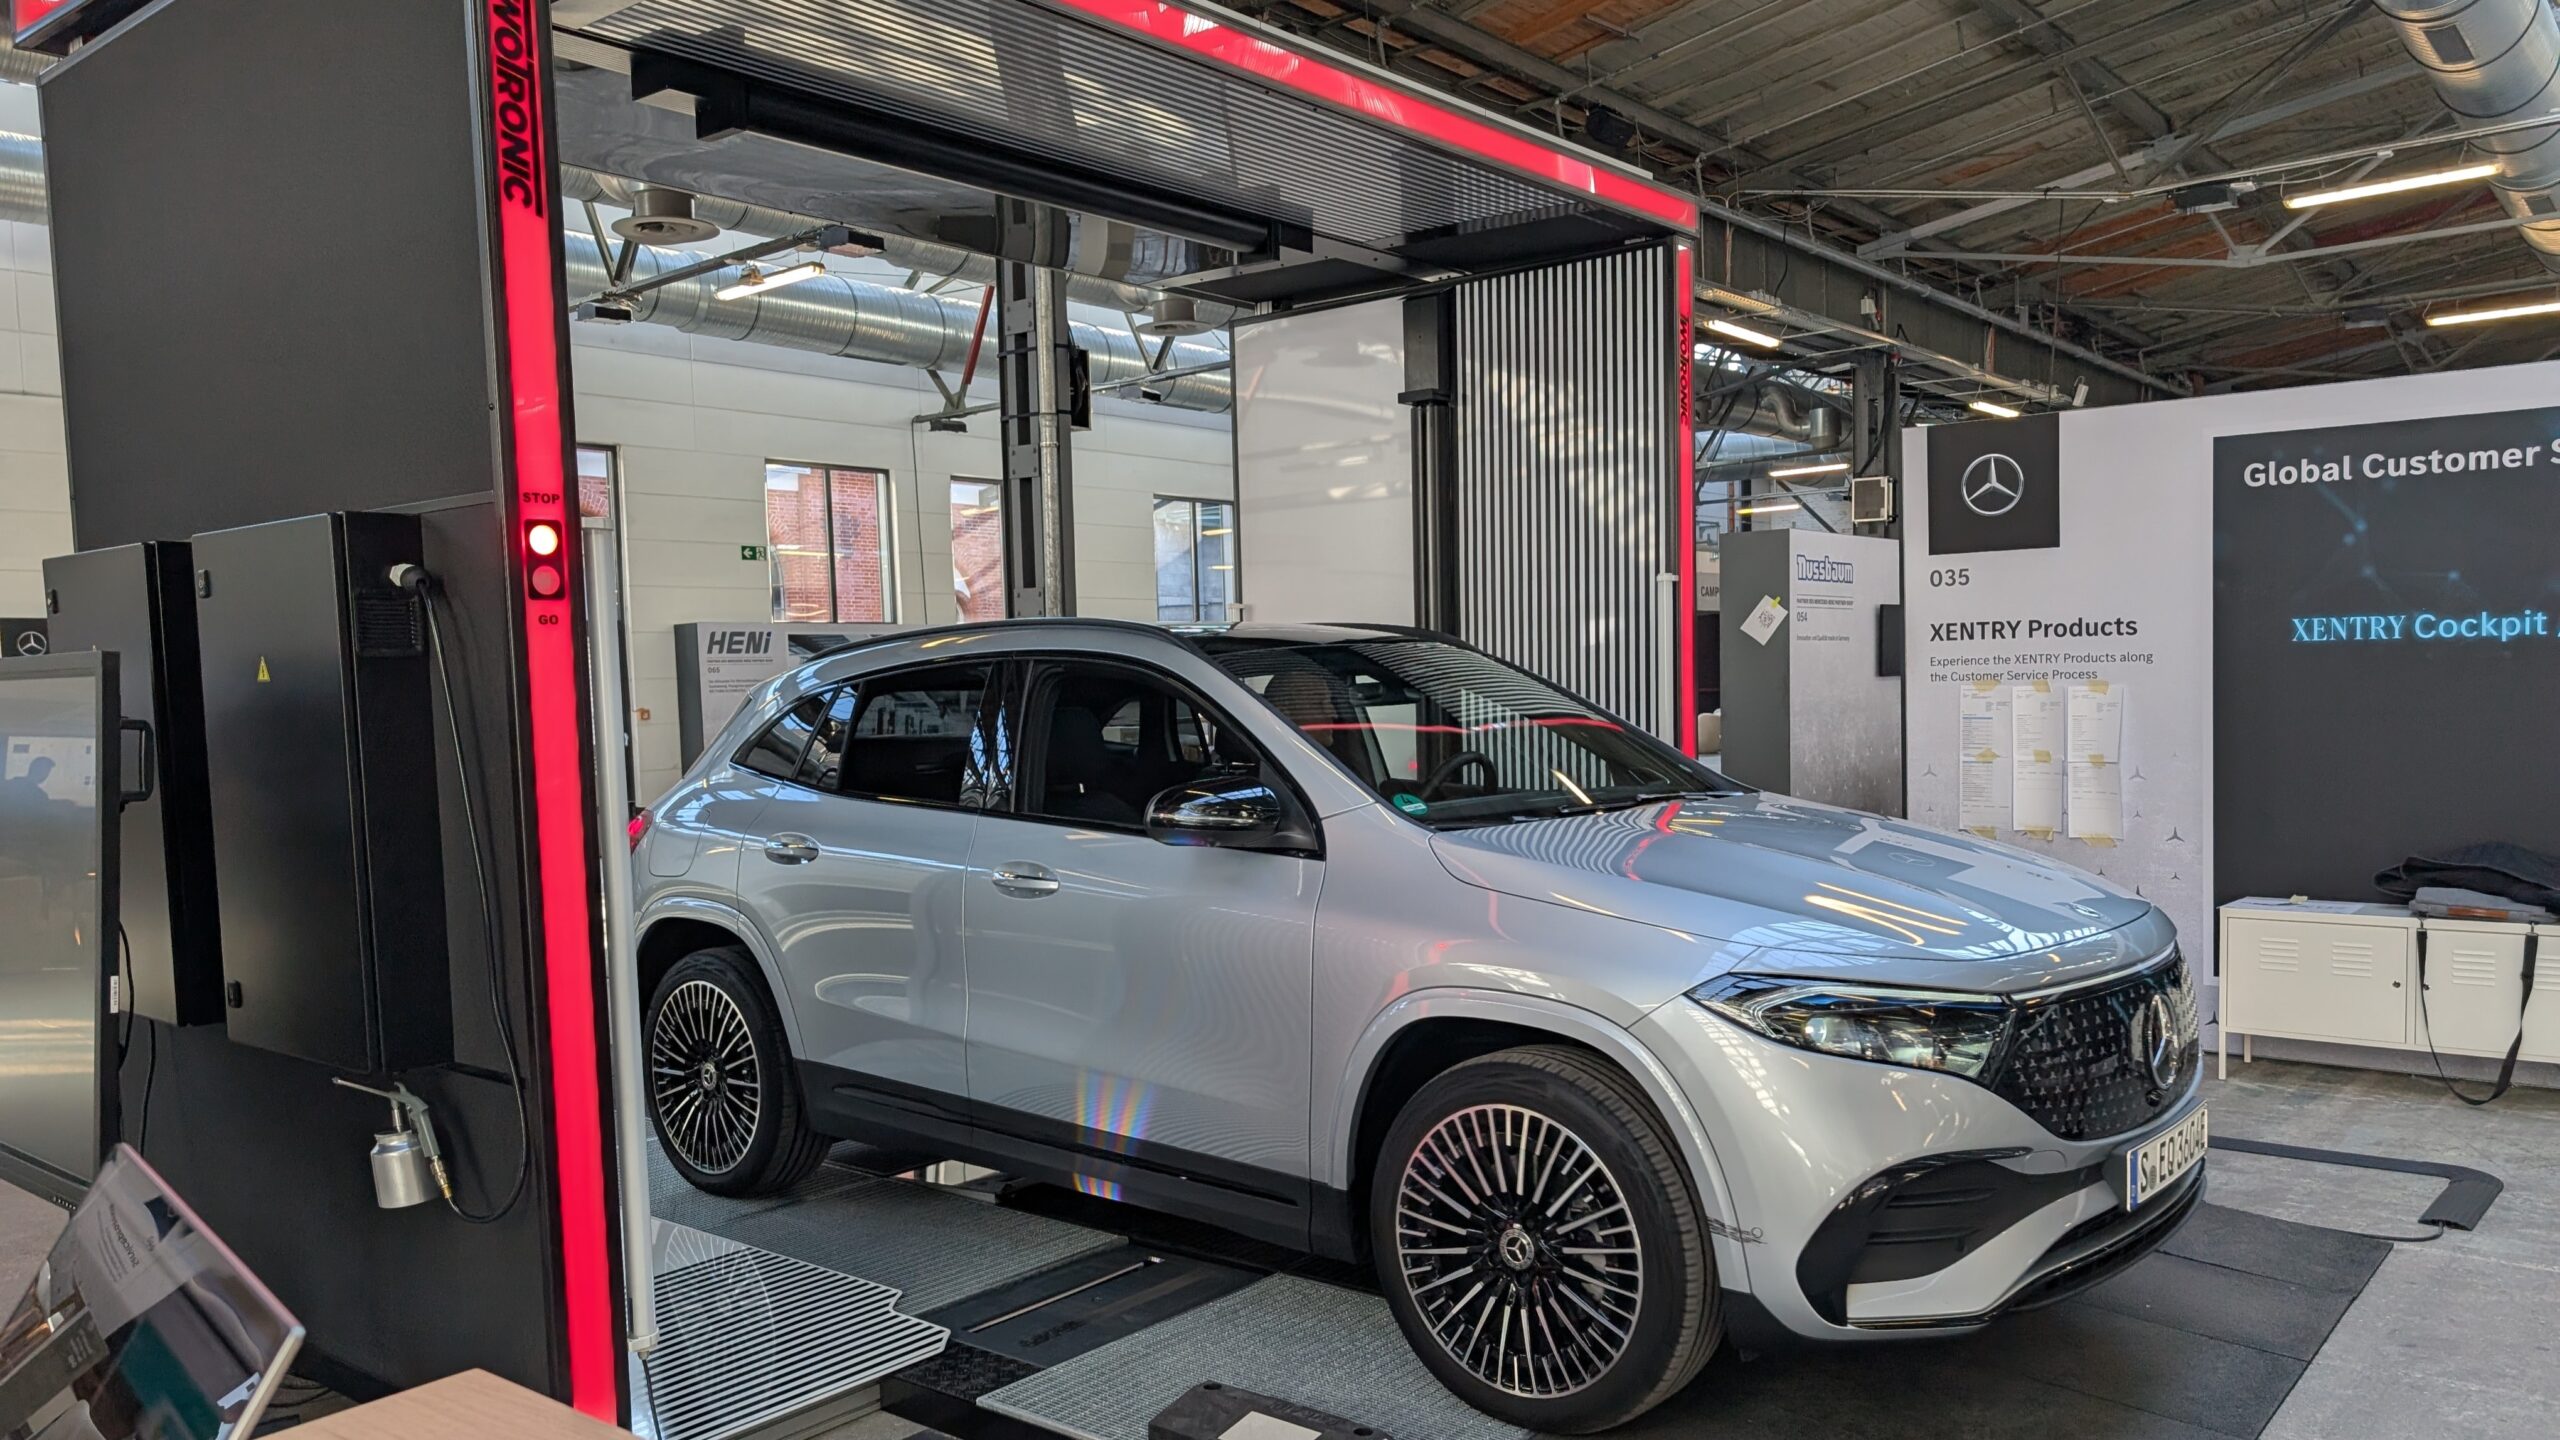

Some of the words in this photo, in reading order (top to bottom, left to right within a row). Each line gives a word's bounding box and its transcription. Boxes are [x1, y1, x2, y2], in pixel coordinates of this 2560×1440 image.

[493, 0, 544, 218] WOTRONIC
[2243, 455, 2352, 487] Global
[2362, 445, 2541, 478] Customer
[522, 491, 561, 504] STOP
[1929, 567, 1970, 588] 035
[538, 614, 559, 626] GO
[1929, 620, 2022, 642] XENTRY
[2028, 617, 2138, 639] Products
[2292, 615, 2406, 642] XENTRY
[2414, 609, 2547, 642] Cockpit
[1929, 655, 1990, 669] Experience
[1993, 654, 2012, 665] the
[2014, 653, 2060, 665] XENTRY
[2063, 652, 2116, 664] Products
[2119, 651, 2154, 664] along
[1930, 672, 1948, 682] the
[1950, 670, 2003, 682] Customer
[2006, 669, 2049, 681] Service
[2052, 669, 2098, 680] Process
[2140, 1151, 2149, 1194] S
